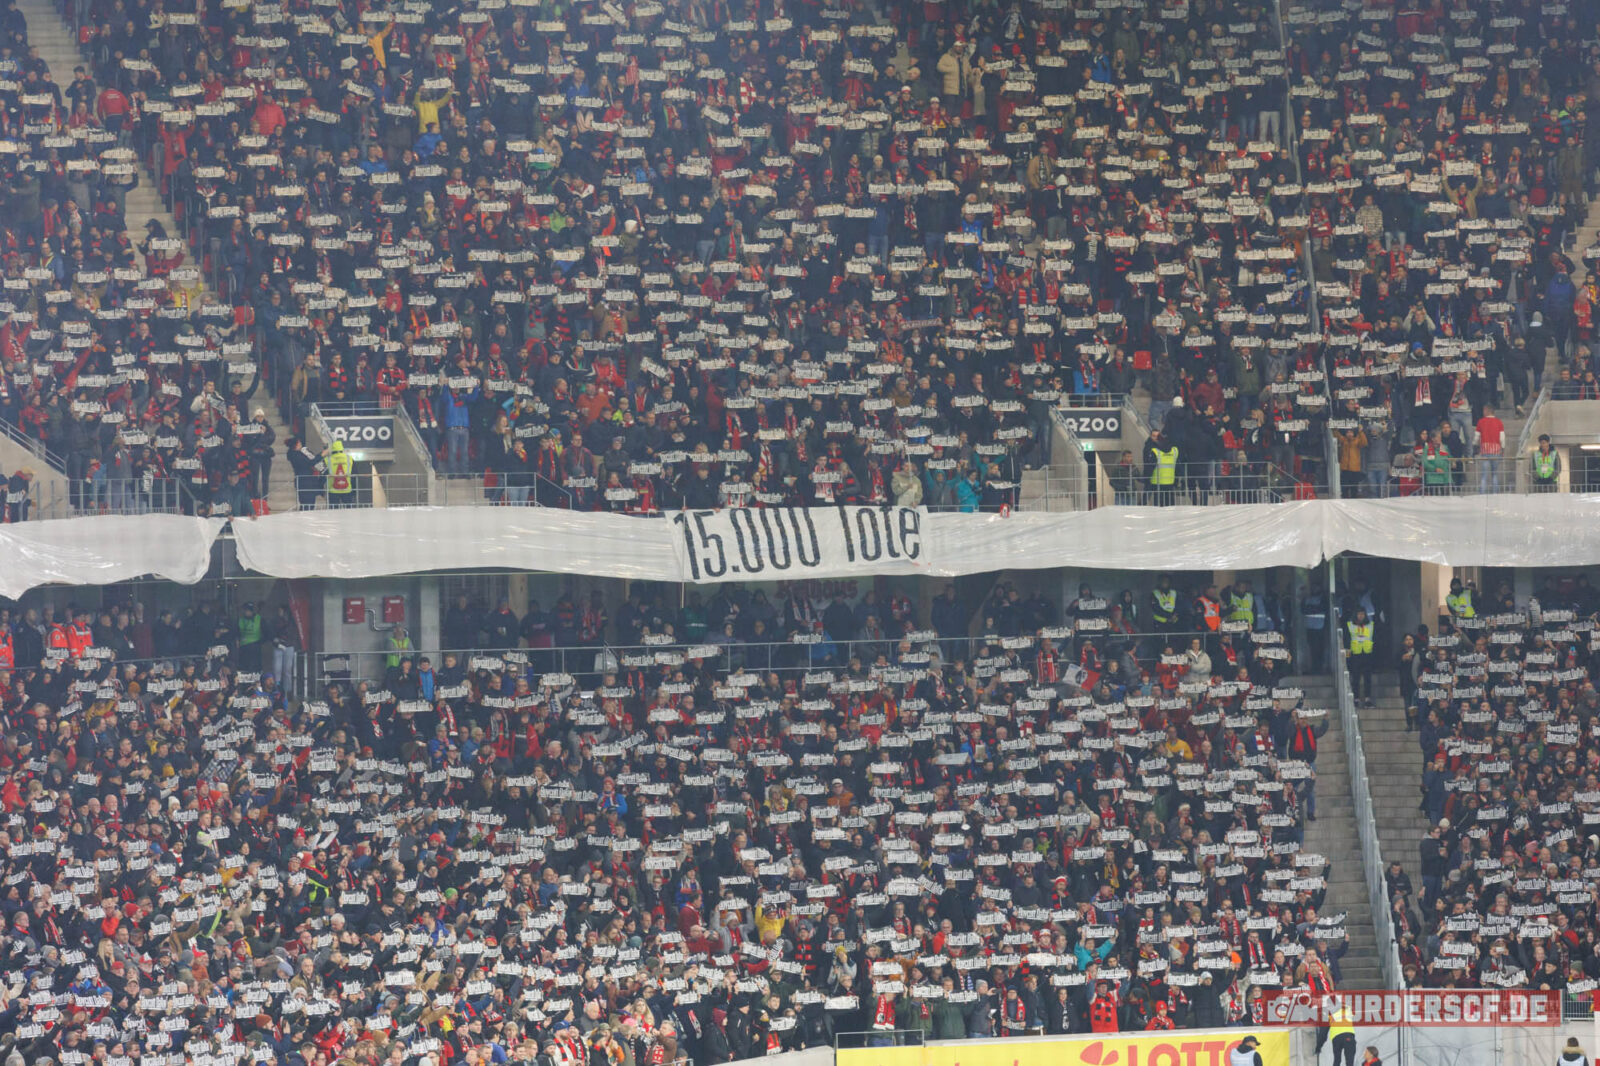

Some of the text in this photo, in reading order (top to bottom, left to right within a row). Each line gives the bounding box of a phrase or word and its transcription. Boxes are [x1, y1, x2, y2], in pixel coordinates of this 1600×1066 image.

[1066, 418, 1118, 432] AZOO
[328, 426, 391, 441] AZOO
[674, 507, 820, 580] 15.000
